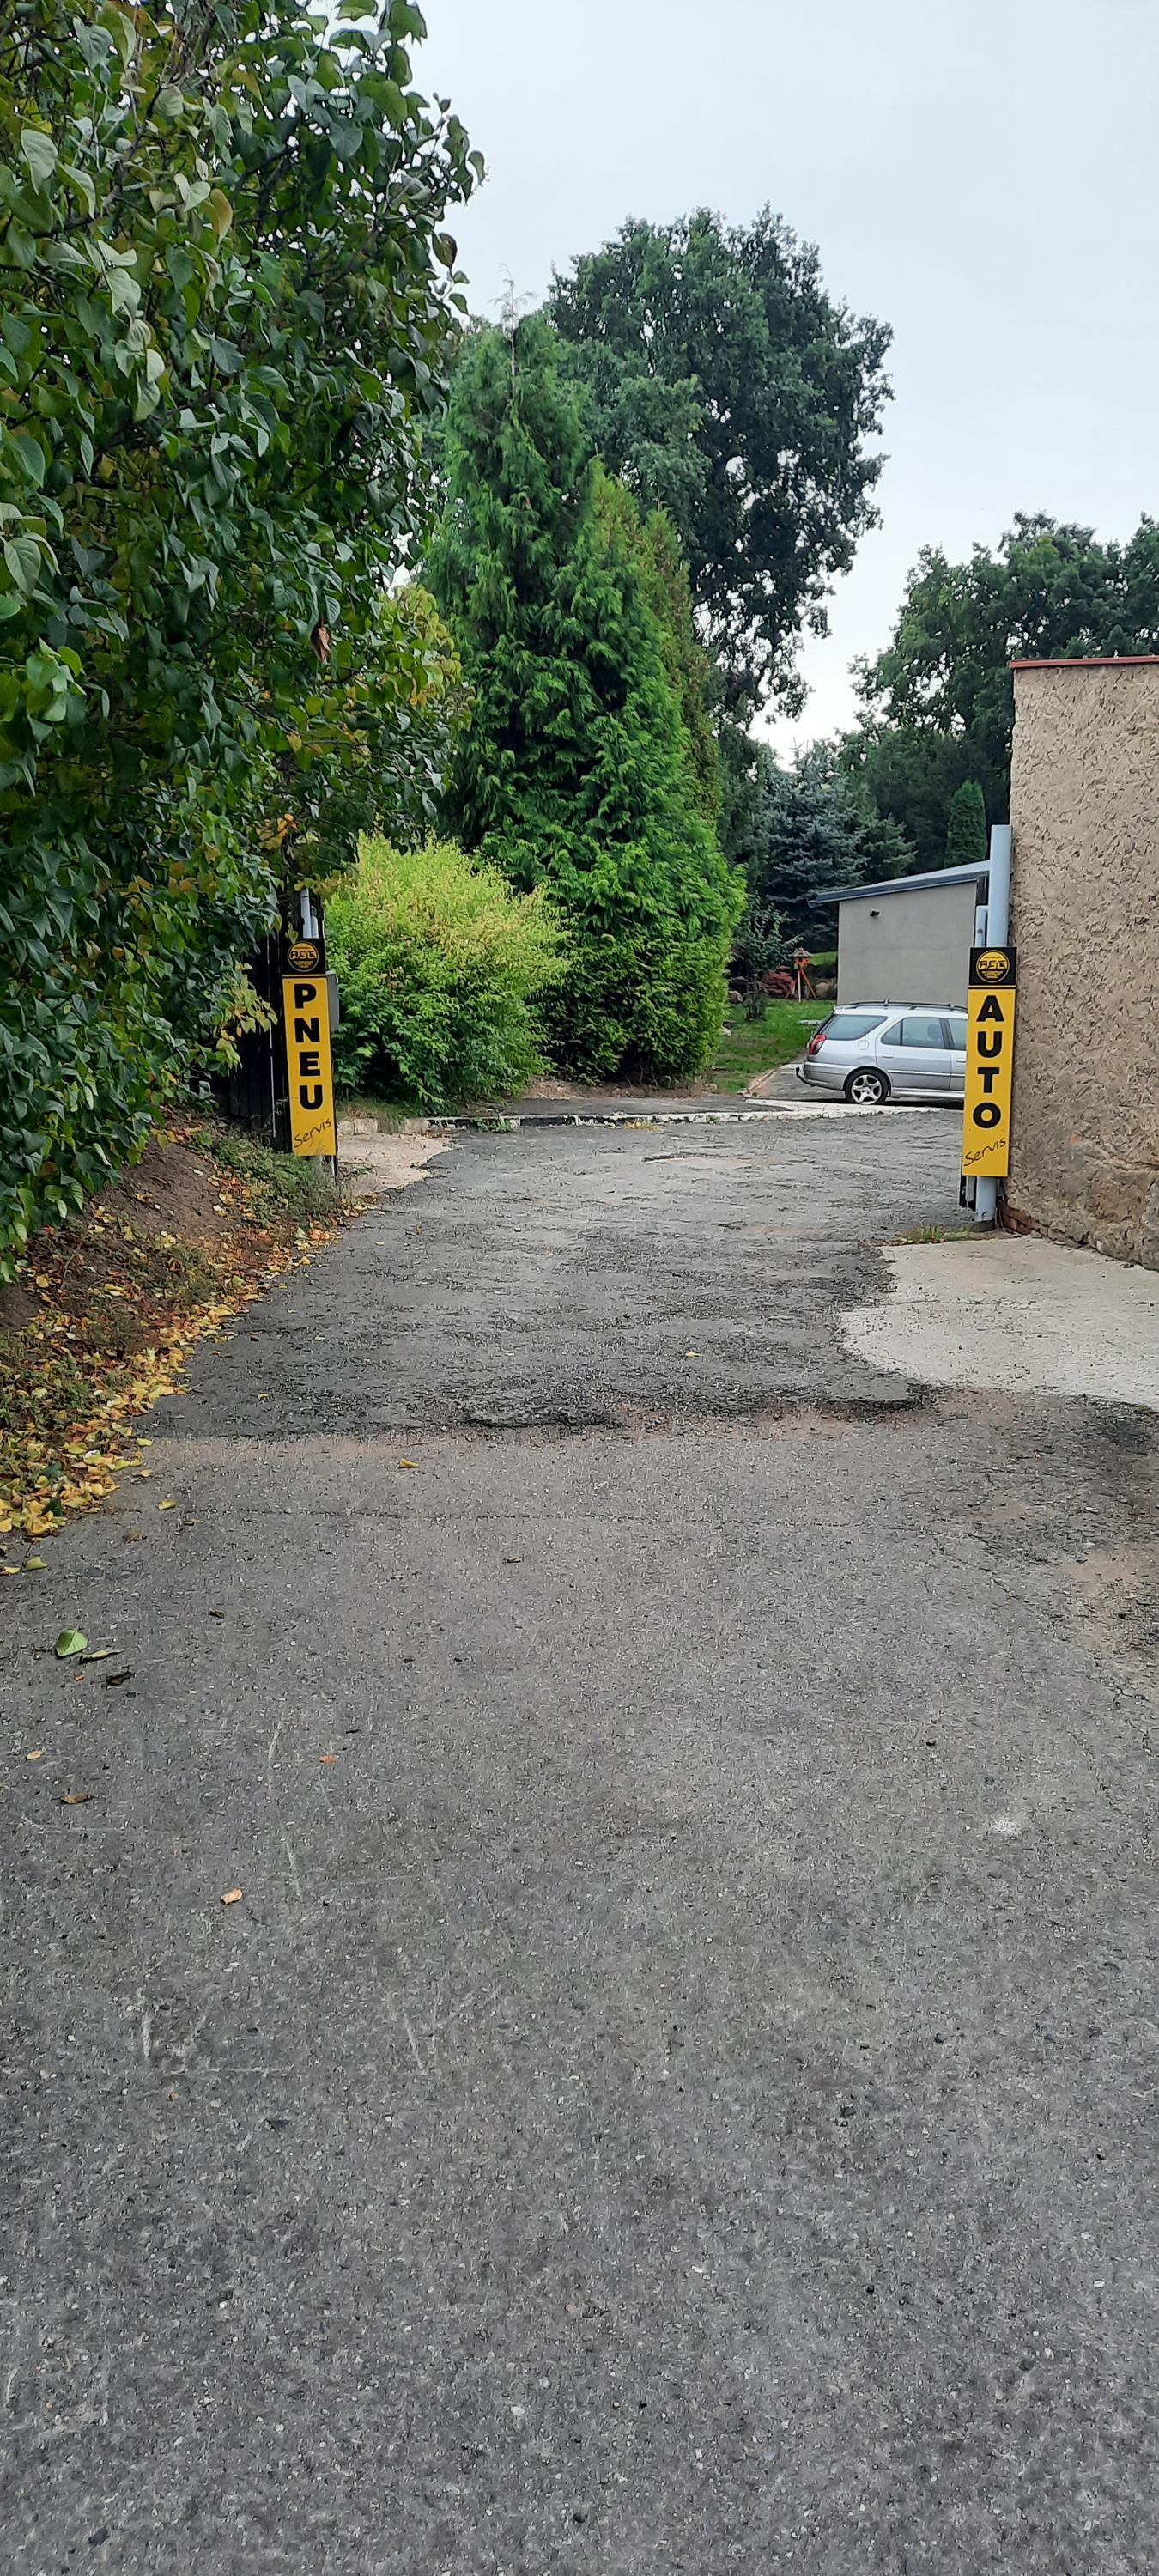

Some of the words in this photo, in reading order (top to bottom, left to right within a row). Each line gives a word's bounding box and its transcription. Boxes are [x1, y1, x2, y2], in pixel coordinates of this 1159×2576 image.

[294, 983, 323, 1110] PNEU
[972, 994, 1004, 1129] AUTO
[294, 1118, 331, 1148] Servis
[963, 1138, 1006, 1166] Servis
